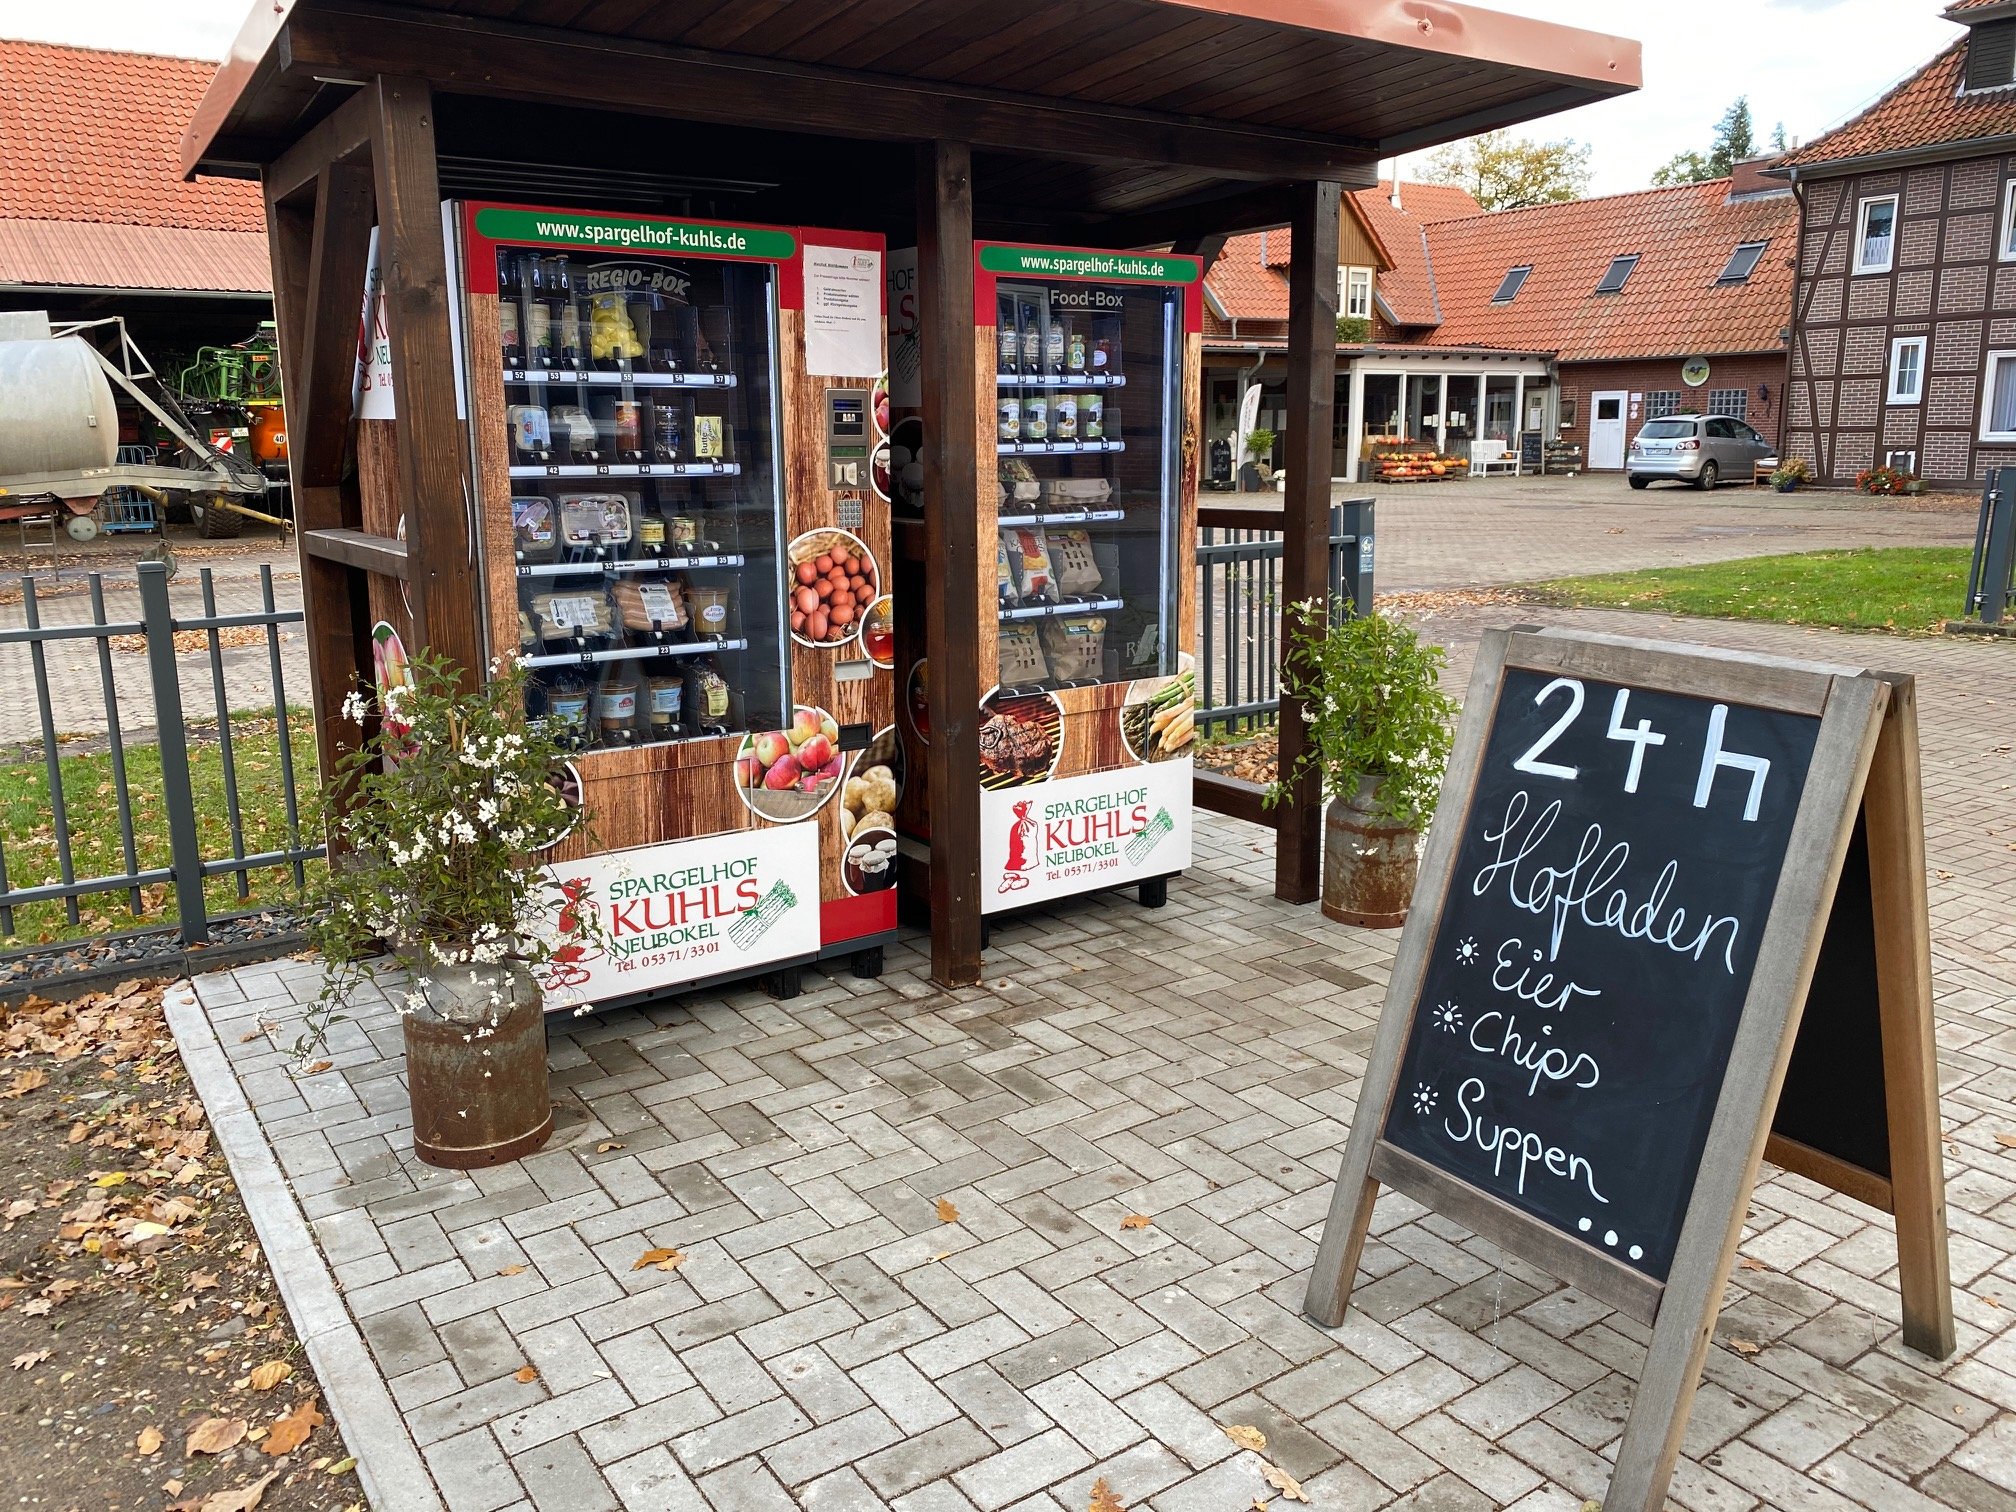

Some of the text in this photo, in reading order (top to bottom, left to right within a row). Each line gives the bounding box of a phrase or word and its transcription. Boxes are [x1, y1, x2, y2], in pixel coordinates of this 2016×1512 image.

[536, 219, 746, 251] www.spargelhof-kuhls.de
[1020, 256, 1164, 277] www.spargelhof-kuhls.de
[587, 269, 691, 296] REGIO-BOX
[1050, 289, 1124, 307] Food-Box
[515, 371, 724, 383] 52 53 54 55 56 57
[275, 435, 284, 443] 40
[549, 466, 558, 474] 42
[599, 466, 608, 474] 43
[676, 465, 685, 473] 45
[604, 562, 613, 570] 32
[660, 646, 669, 654] 23
[1512, 677, 1772, 822] 24 h
[1045, 787, 1148, 820] SPARGELHOF
[1045, 805, 1148, 851] KUHLS
[1045, 841, 1119, 867] NEUBOKEL
[609, 857, 758, 901] SPARGELHOF
[1046, 869, 1062, 881] Tel.
[1472, 790, 1739, 975] Hofladen
[610, 878, 760, 937] KUHLS
[613, 922, 719, 960] NEUBOKEL
[615, 957, 637, 973] Tel.
[1492, 938, 1602, 1013] Eier
[1469, 1011, 1600, 1096] Chips
[1444, 1077, 1609, 1204] Suppen
